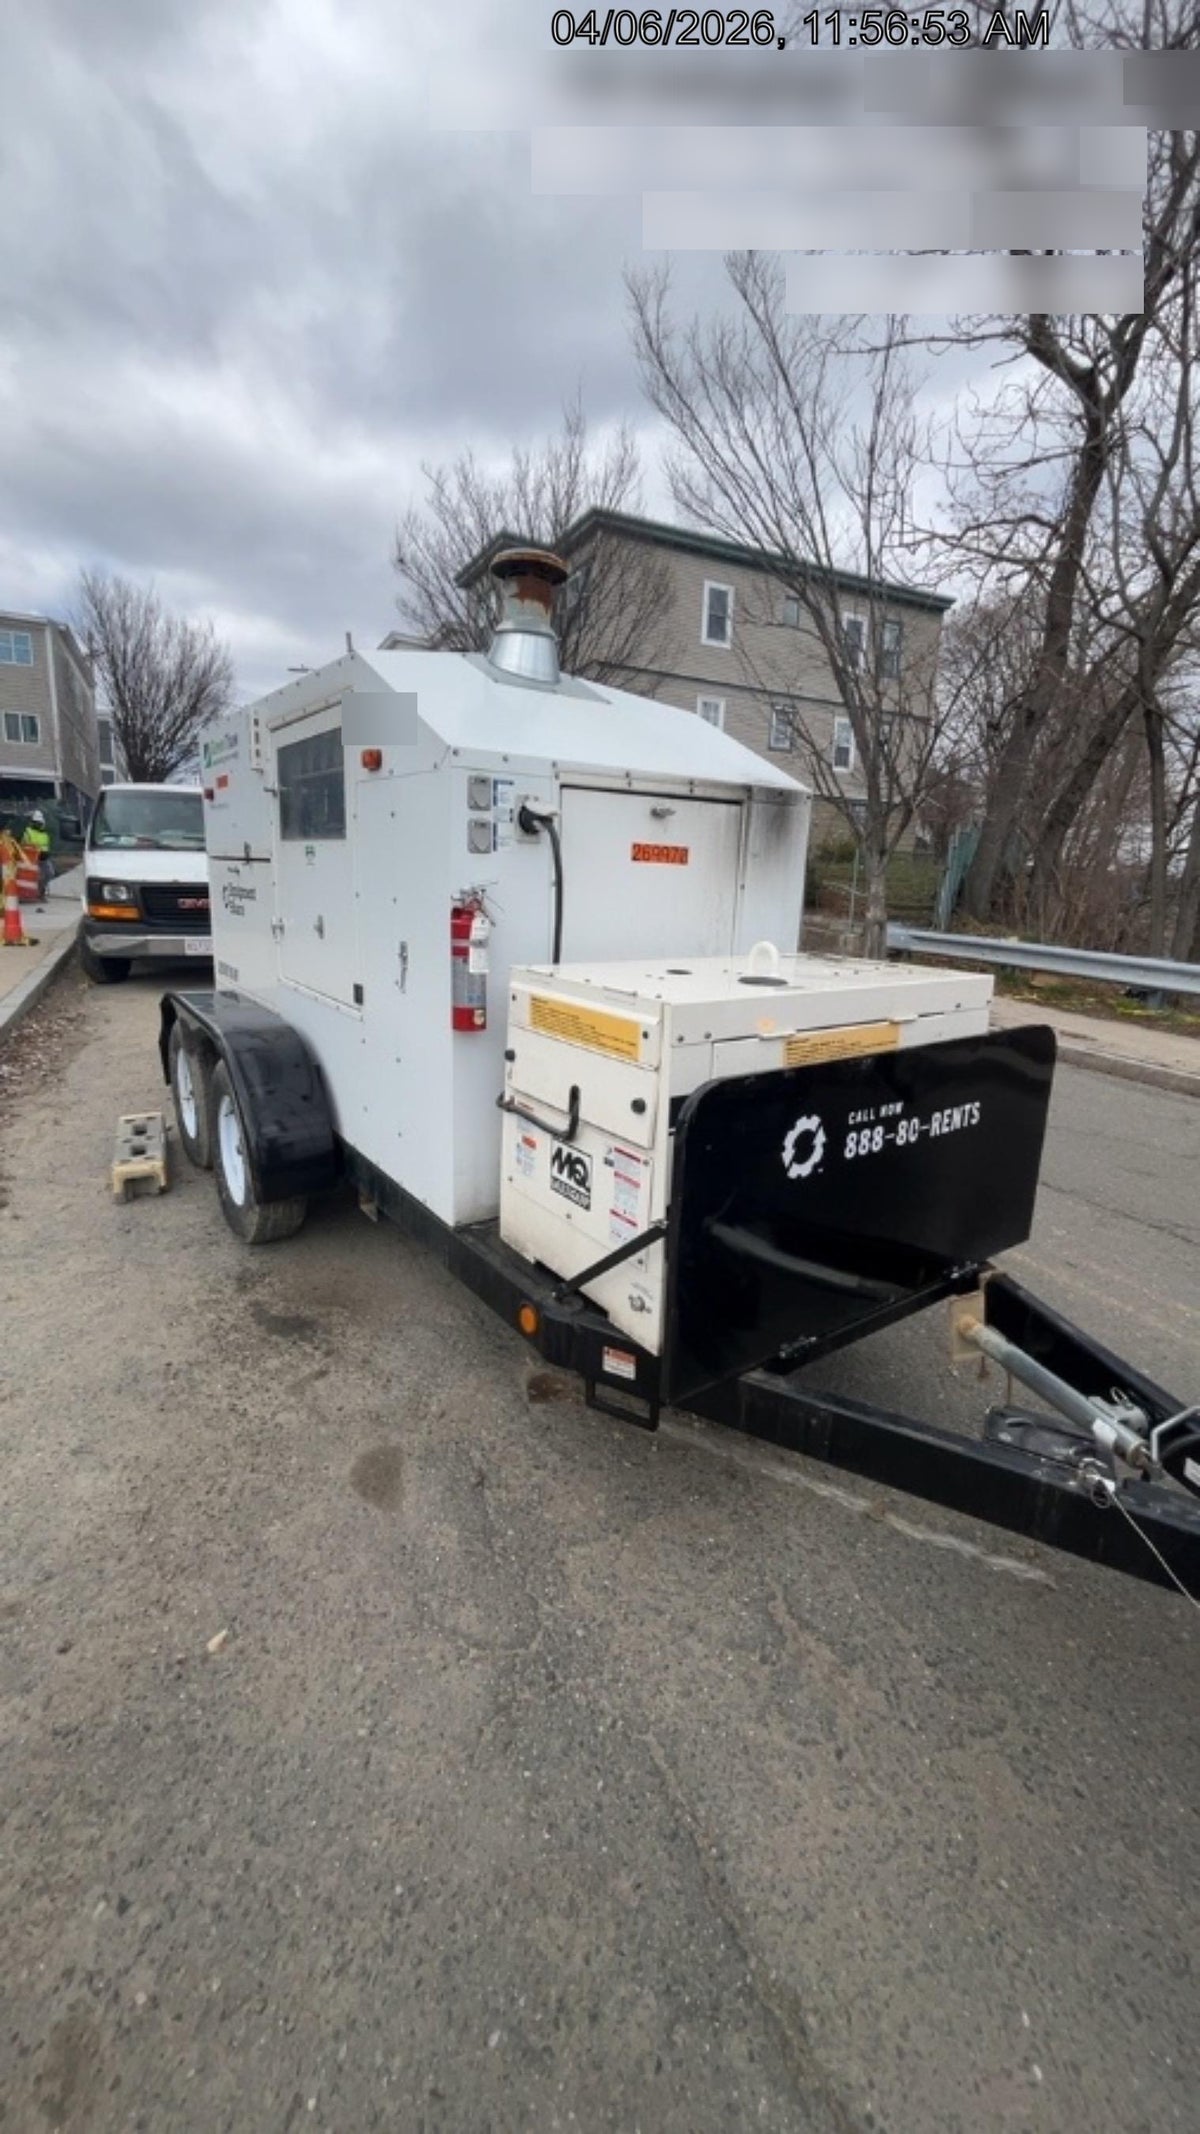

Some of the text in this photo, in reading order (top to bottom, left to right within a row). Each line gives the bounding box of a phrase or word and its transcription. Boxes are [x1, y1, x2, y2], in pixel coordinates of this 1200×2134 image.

[843, 1100, 982, 1159] 888-80-RENTS
[848, 1100, 904, 1125] CALL NOW
